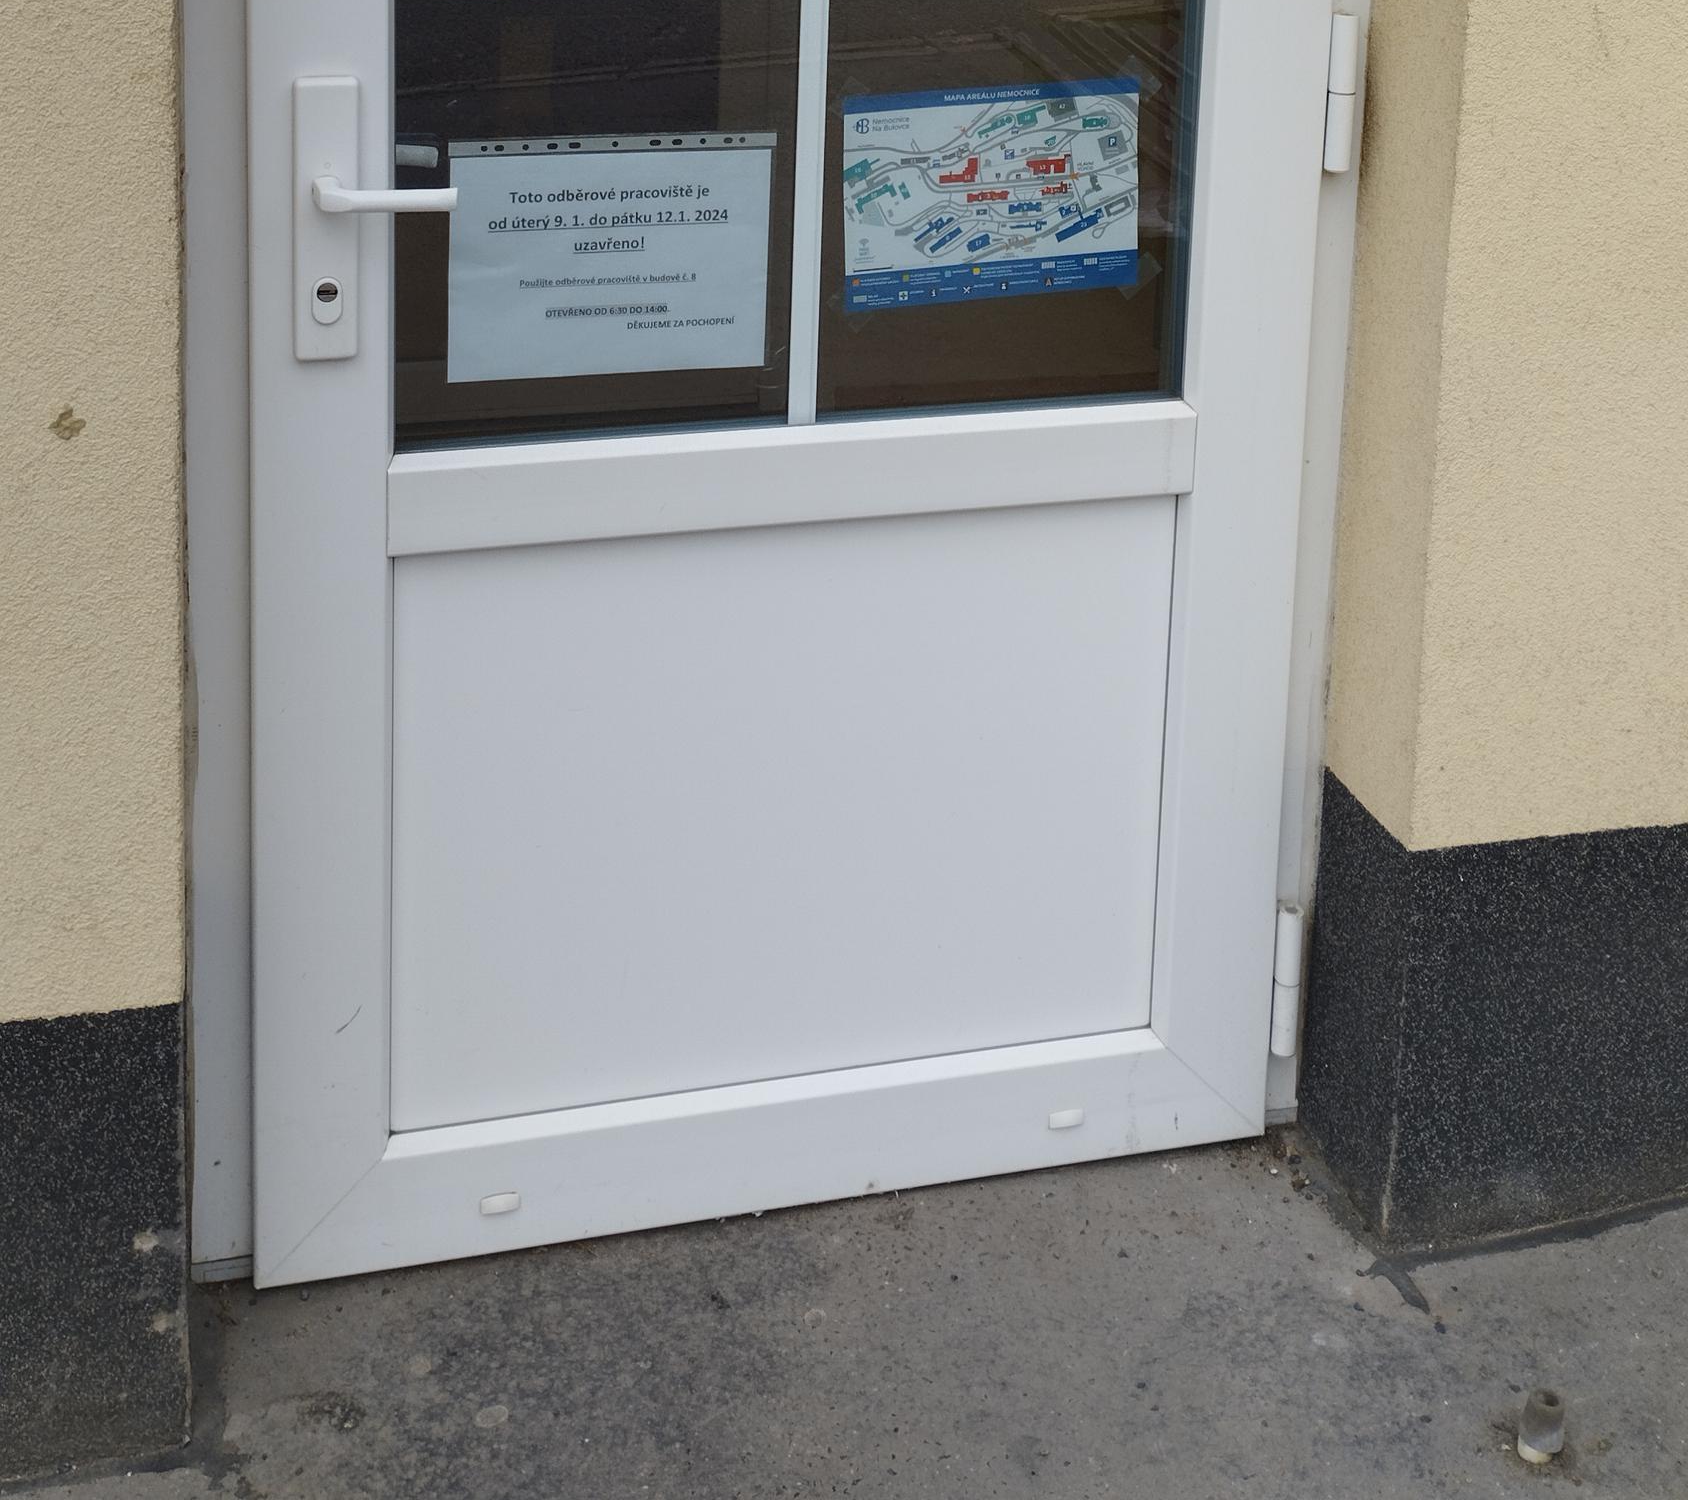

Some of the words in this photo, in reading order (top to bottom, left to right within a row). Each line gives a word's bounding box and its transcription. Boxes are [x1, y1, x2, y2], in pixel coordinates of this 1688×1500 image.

[967, 90, 994, 100] AREÁLU
[997, 88, 1039, 99] NEMOCNICE
[509, 191, 542, 204] Toto
[547, 188, 616, 202] odběrové
[620, 185, 693, 202] pracoviště
[696, 184, 709, 199] je
[488, 216, 507, 230] od
[512, 214, 550, 231] úterý
[555, 214, 567, 228] 9.
[572, 214, 584, 226] 1.
[589, 212, 606, 226] do
[612, 211, 651, 226] pátku
[657, 210, 691, 223] 12.1.
[695, 209, 728, 222] 2024
[574, 237, 645, 252] uzavřeno!
[520, 278, 552, 288] Použijte
[556, 276, 595, 286] odběrové
[598, 275, 640, 286] pracoviště
[650, 273, 679, 282] budově
[682, 273, 689, 282] č.
[691, 273, 696, 281] 8
[546, 306, 592, 318] OTEVŘENO
[594, 307, 607, 316] OD
[609, 306, 627, 315] 6:30
[630, 305, 642, 314] DO
[627, 319, 671, 330] DĚKUJEME
[674, 319, 684, 328] ZA
[686, 316, 734, 328] POCHOPENÍ
